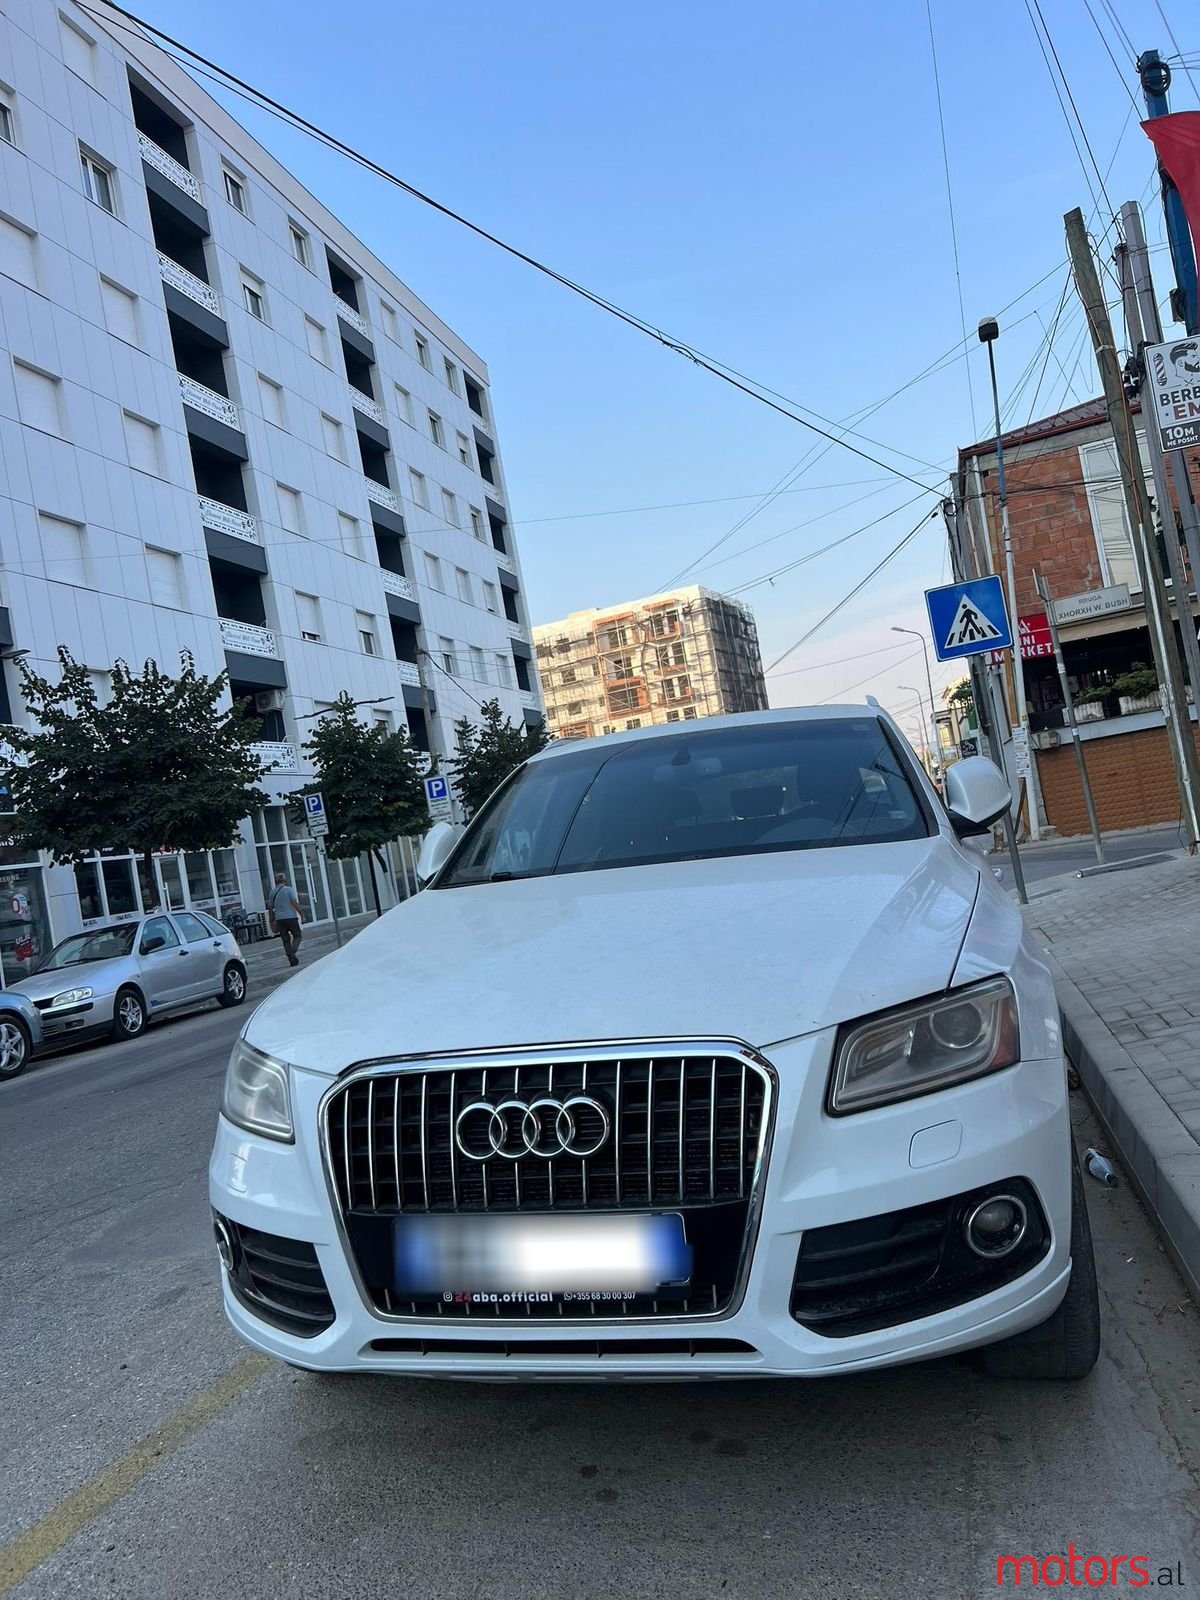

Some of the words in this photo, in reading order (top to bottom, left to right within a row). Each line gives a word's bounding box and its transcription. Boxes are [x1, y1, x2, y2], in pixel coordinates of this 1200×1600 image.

[1178, 435, 1199, 445] POSHT
[1078, 594, 1103, 604] RRUGA
[1058, 606, 1092, 620] XHORXH
[1104, 598, 1129, 609] BUSH
[994, 642, 1053, 662] MRKET
[573, 1291, 590, 1300] +355
[591, 1291, 601, 1300] 68
[602, 1291, 611, 1300] 30
[612, 1291, 622, 1300] 00
[622, 1291, 636, 1300] 307
